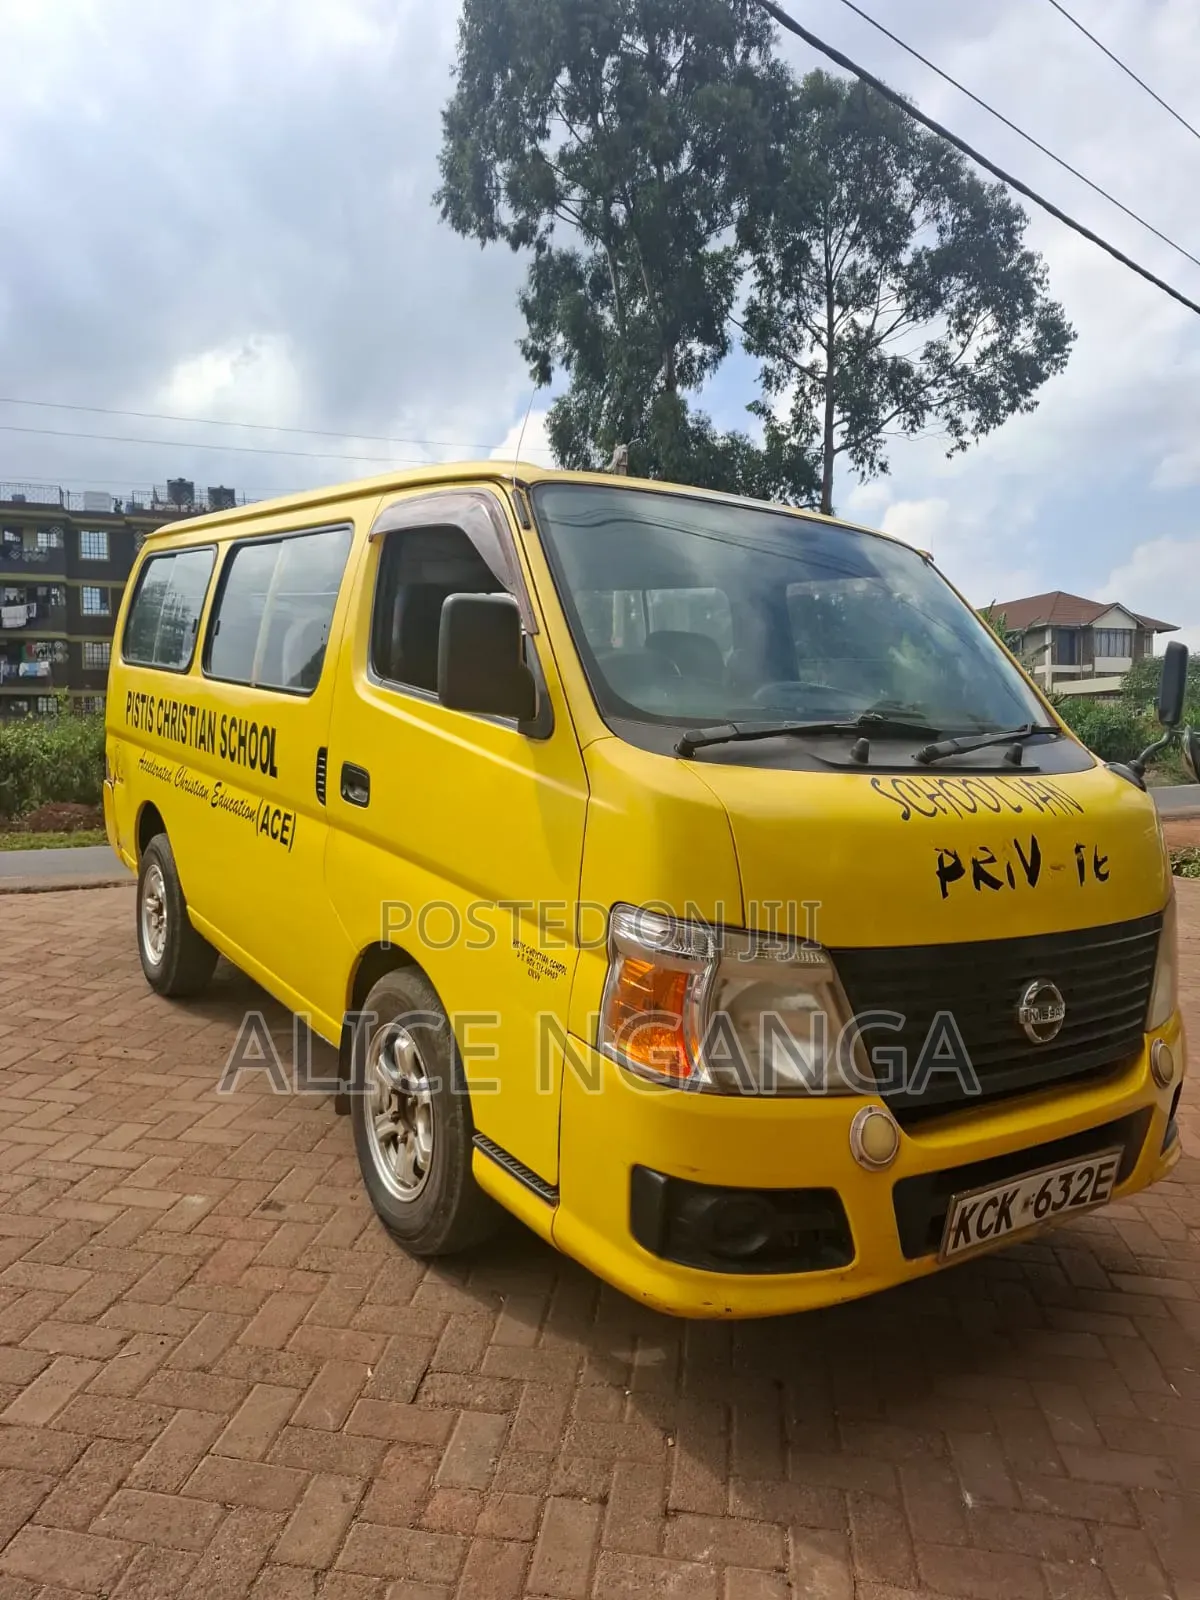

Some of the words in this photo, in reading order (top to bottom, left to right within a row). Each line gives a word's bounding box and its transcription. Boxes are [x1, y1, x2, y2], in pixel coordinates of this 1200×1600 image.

[126, 690, 155, 734] PISTIS
[156, 697, 217, 756] CHRISTIAN
[219, 714, 278, 780] SCHOOL
[175, 765, 209, 801] Christian
[211, 781, 256, 823] Education
[256, 798, 296, 853] (ACE)
[871, 776, 1023, 821] SCHOOL
[1013, 777, 1085, 817] VAN
[952, 1187, 1021, 1249] KCK
[1033, 1161, 1115, 1219] 632E
